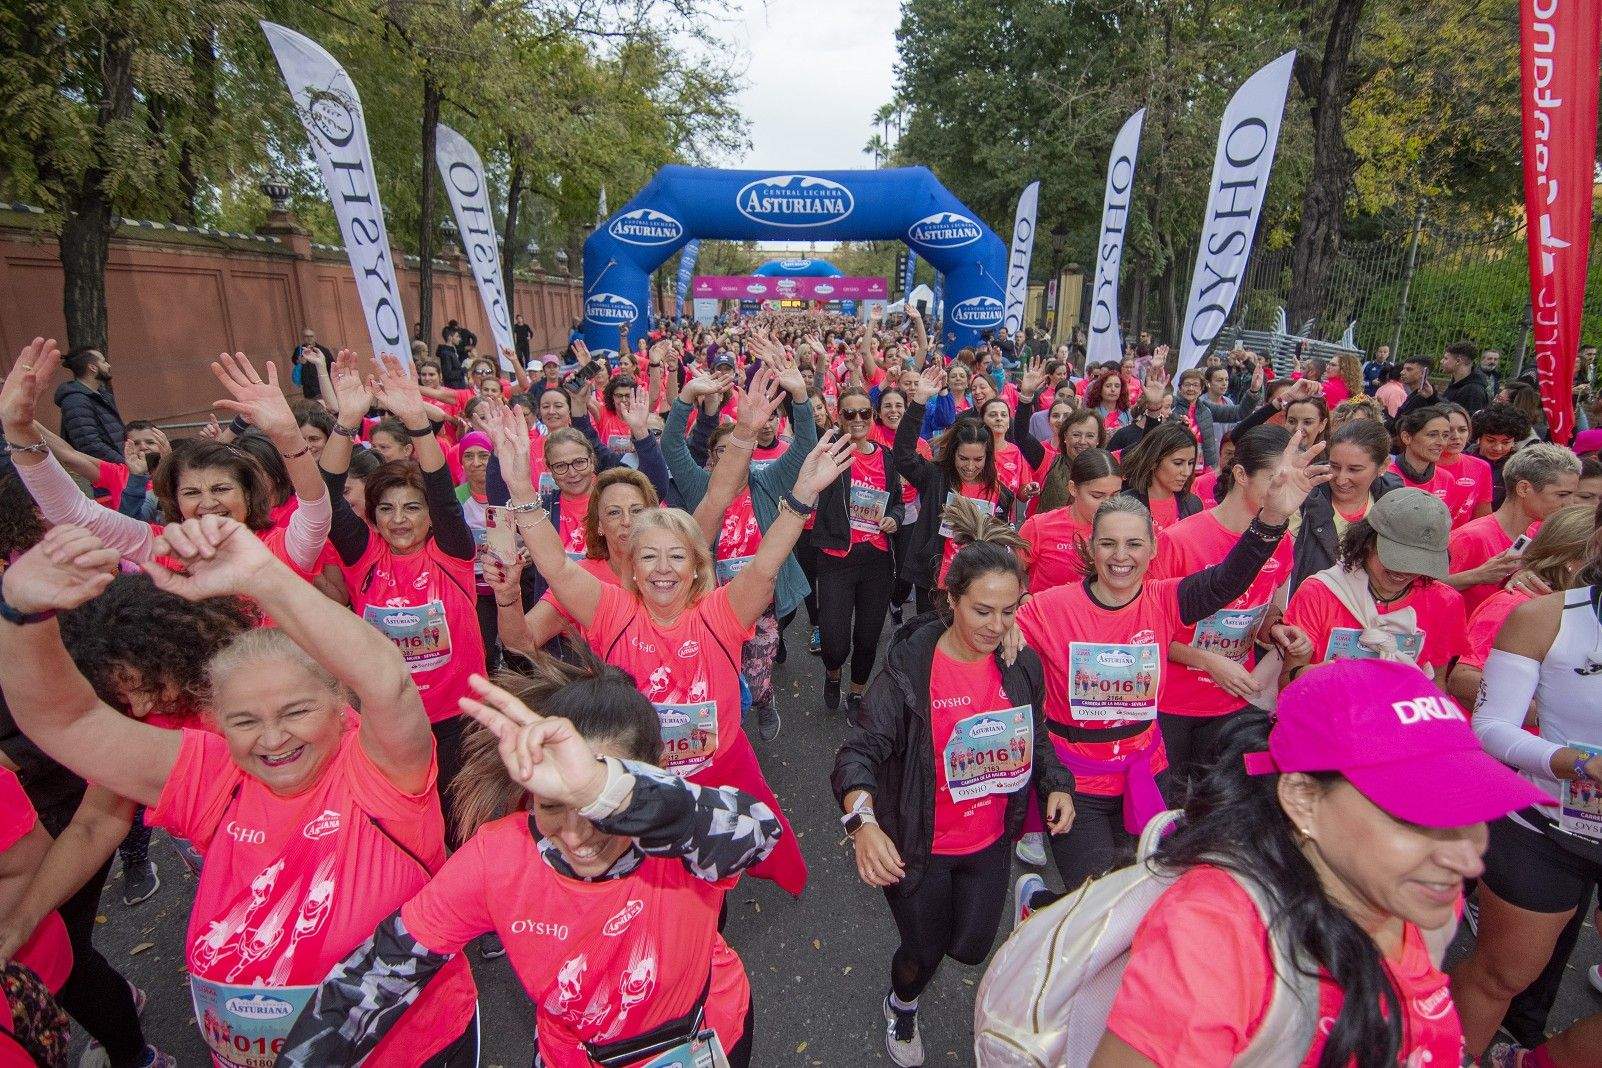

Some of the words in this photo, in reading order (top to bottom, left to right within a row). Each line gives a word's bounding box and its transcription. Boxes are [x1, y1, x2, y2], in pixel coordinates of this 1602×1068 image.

[745, 189, 846, 214] ASTURIANA
[613, 221, 678, 238] ASTURIANA
[914, 226, 978, 241] ASTURIANA
[1191, 116, 1268, 347] OYSHO
[1092, 155, 1132, 333] OYSHO
[1004, 217, 1032, 337] OYSHO
[1100, 680, 1134, 692] 016
[932, 695, 972, 710] OYSHO
[971, 724, 1005, 737] ASTURIANA
[975, 749, 1009, 766] 016
[958, 784, 987, 797] OYSHO
[511, 919, 569, 941] OYSHO
[229, 1000, 289, 1015] ASTURIANA
[234, 1034, 288, 1056] 016
[246, 1058, 273, 1067] 6180
